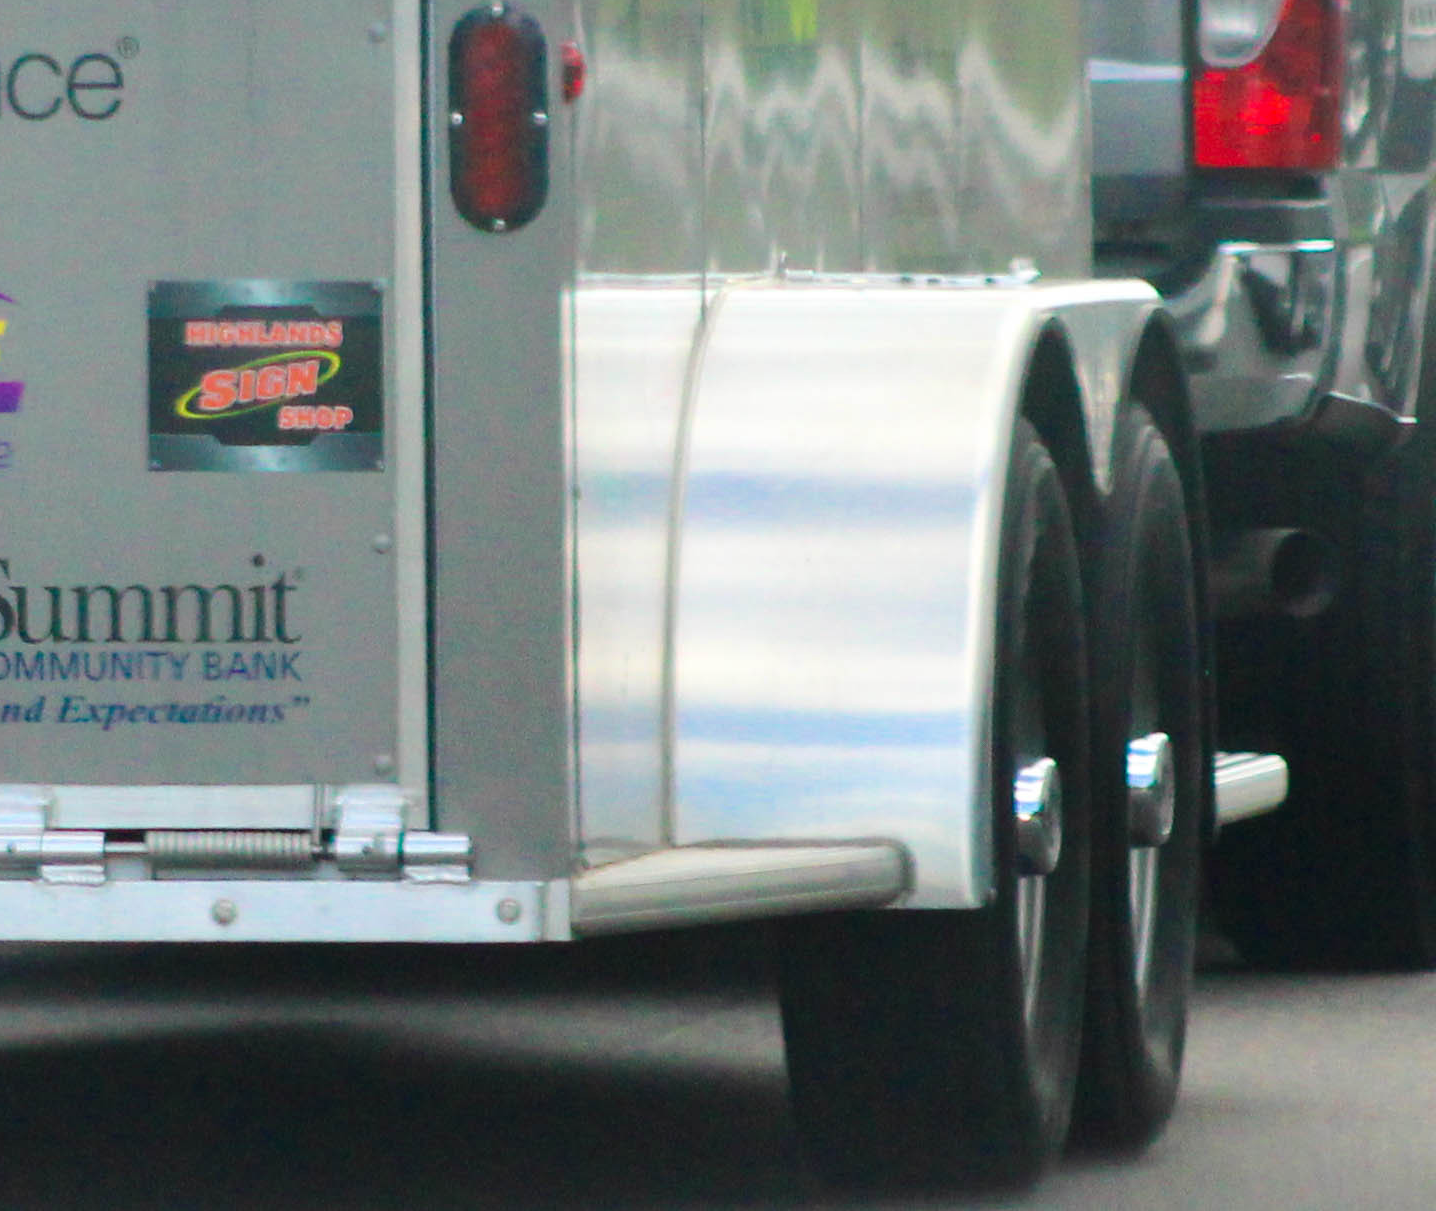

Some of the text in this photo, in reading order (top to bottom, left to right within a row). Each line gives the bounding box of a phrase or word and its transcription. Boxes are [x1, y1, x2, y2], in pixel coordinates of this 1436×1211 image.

[184, 320, 343, 347] HIGHLANDS
[198, 360, 320, 410] SIGN
[278, 405, 354, 430] SHOP
[204, 651, 303, 681] BANK
